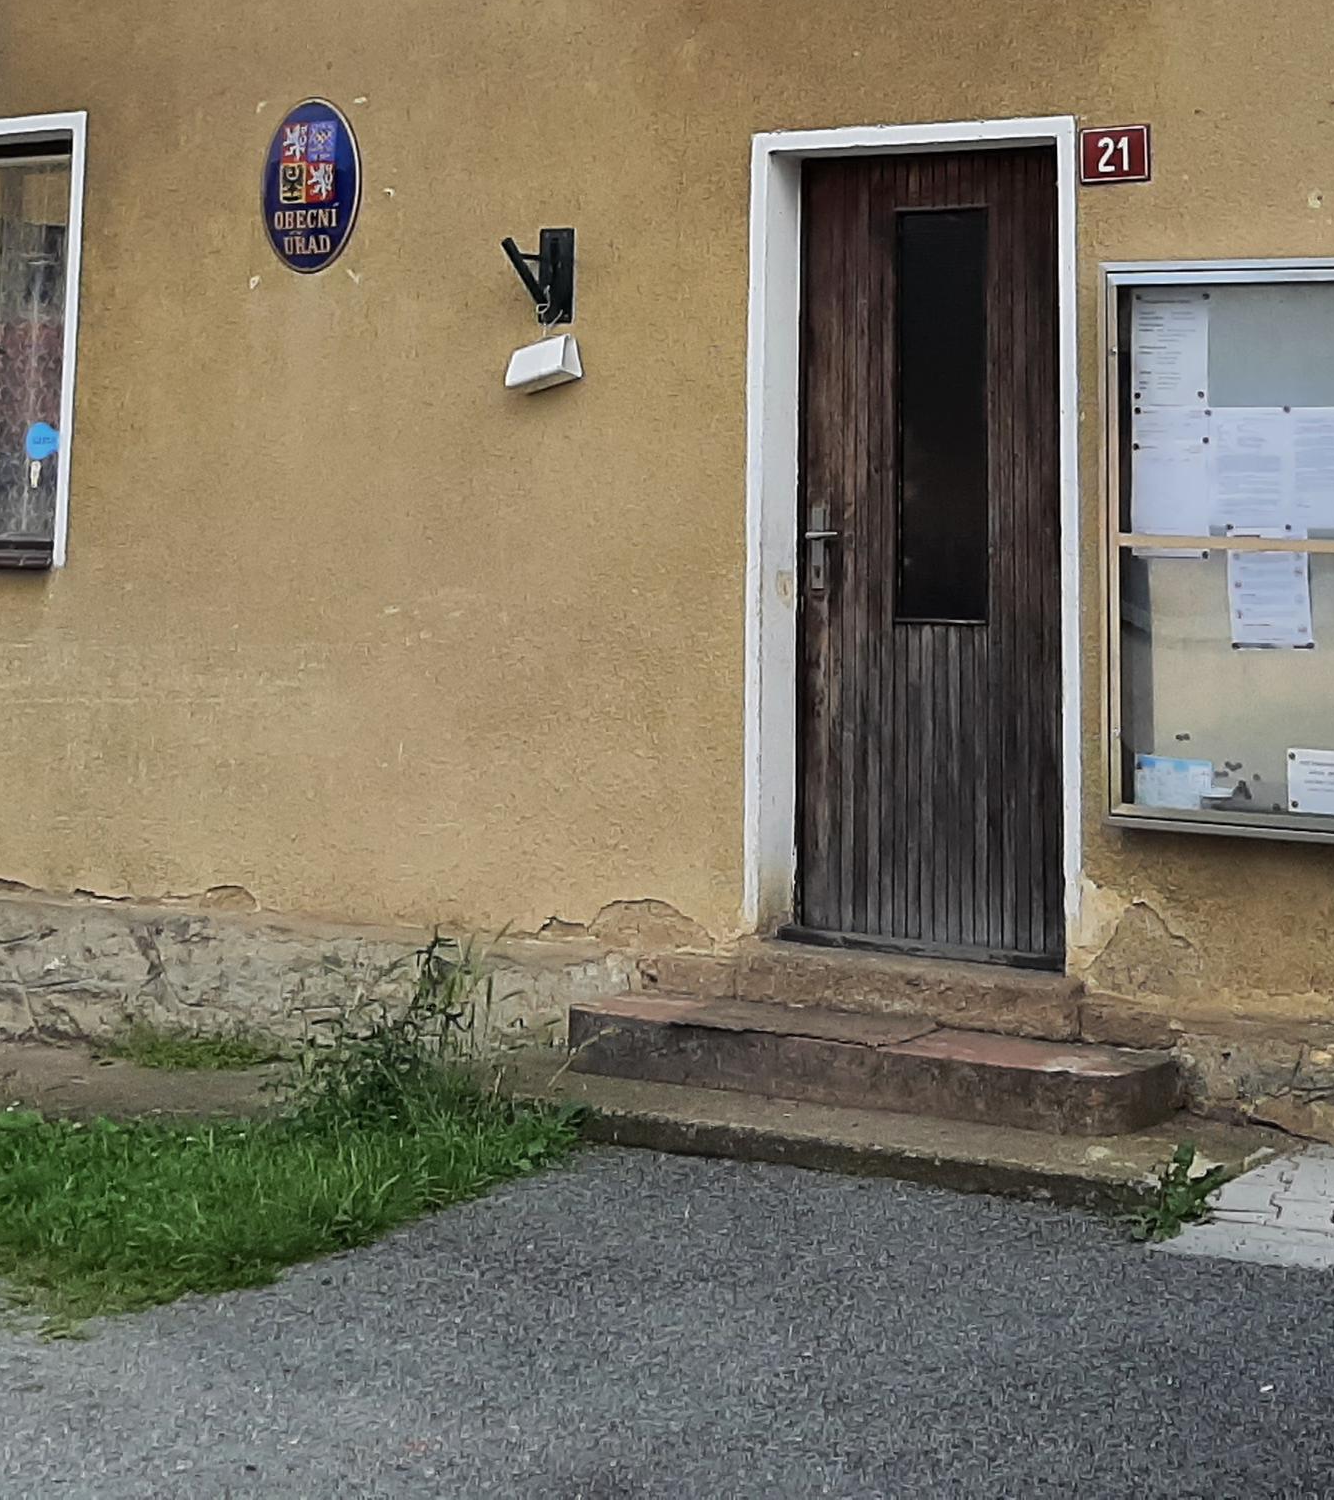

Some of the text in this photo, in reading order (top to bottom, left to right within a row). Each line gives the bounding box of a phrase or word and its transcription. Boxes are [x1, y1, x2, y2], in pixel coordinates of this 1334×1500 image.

[1097, 136, 1130, 173] 21
[274, 203, 339, 230] OBECNÍ
[284, 230, 331, 254] ÚŘAD
